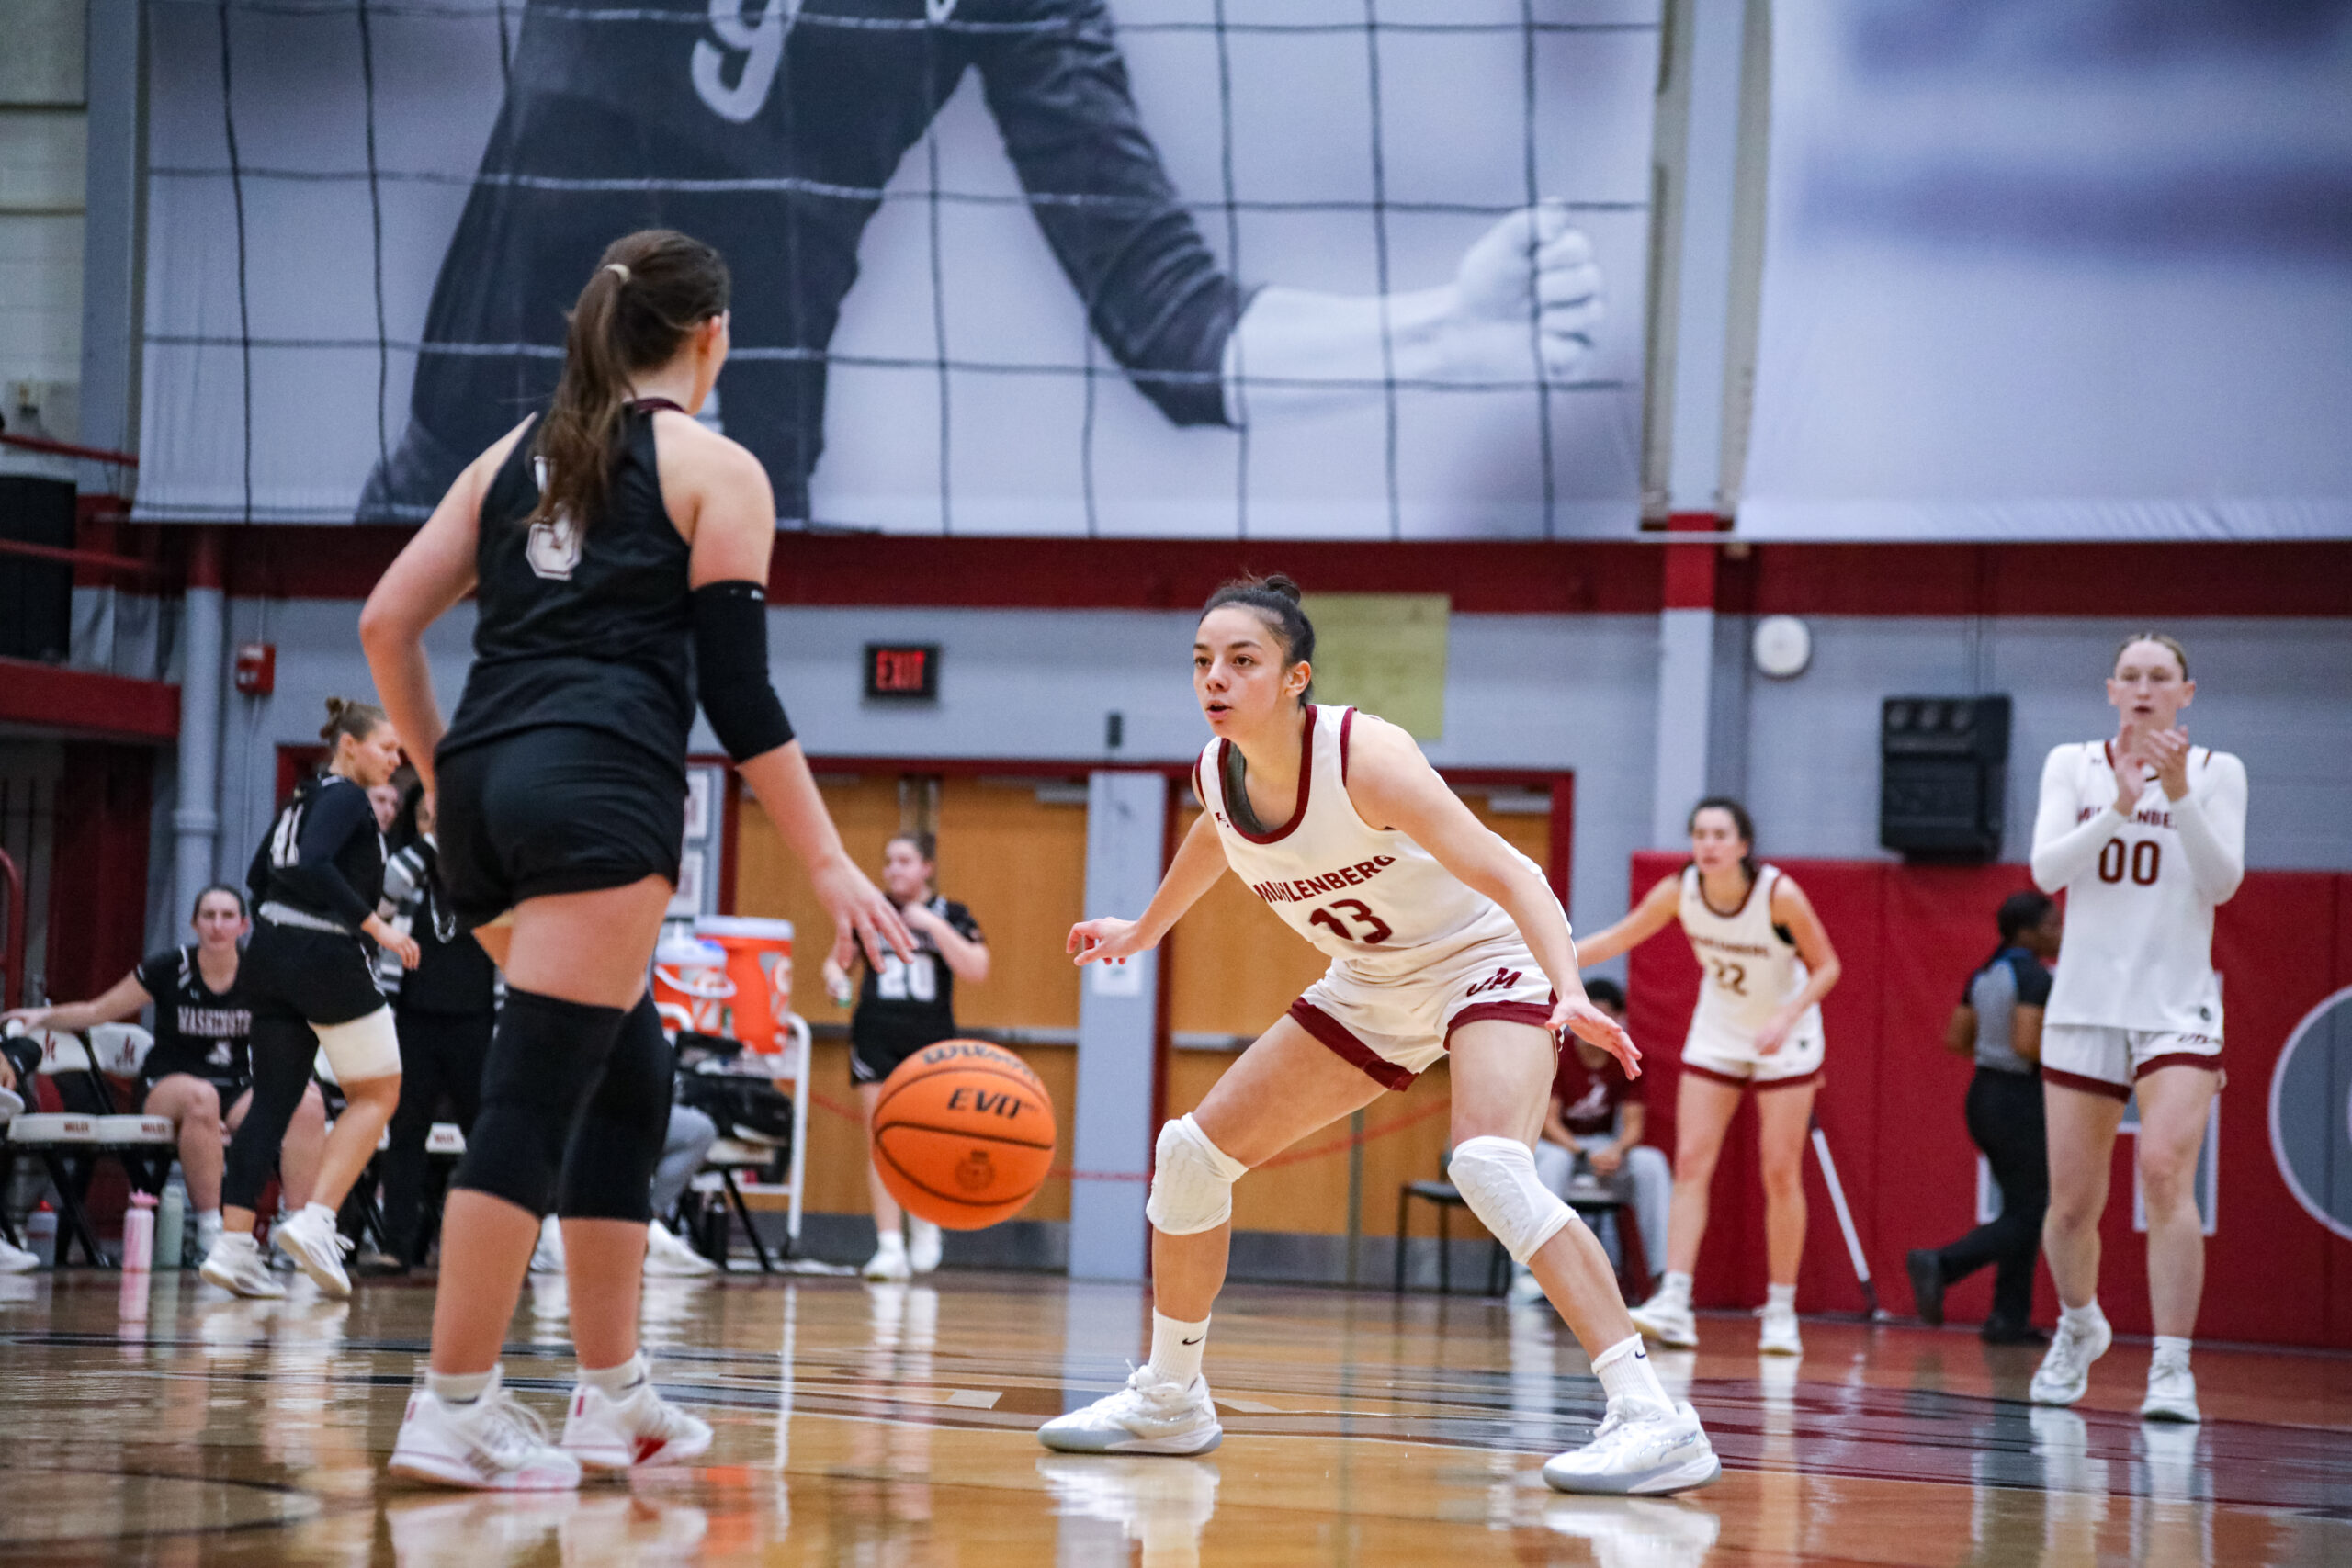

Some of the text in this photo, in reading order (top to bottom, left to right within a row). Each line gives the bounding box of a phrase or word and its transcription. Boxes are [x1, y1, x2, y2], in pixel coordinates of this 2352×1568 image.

[876, 649, 926, 691] EXIT
[1252, 854, 1396, 904] MUHLENBERG
[2098, 837, 2161, 886] 00
[1308, 897, 1393, 945] 13
